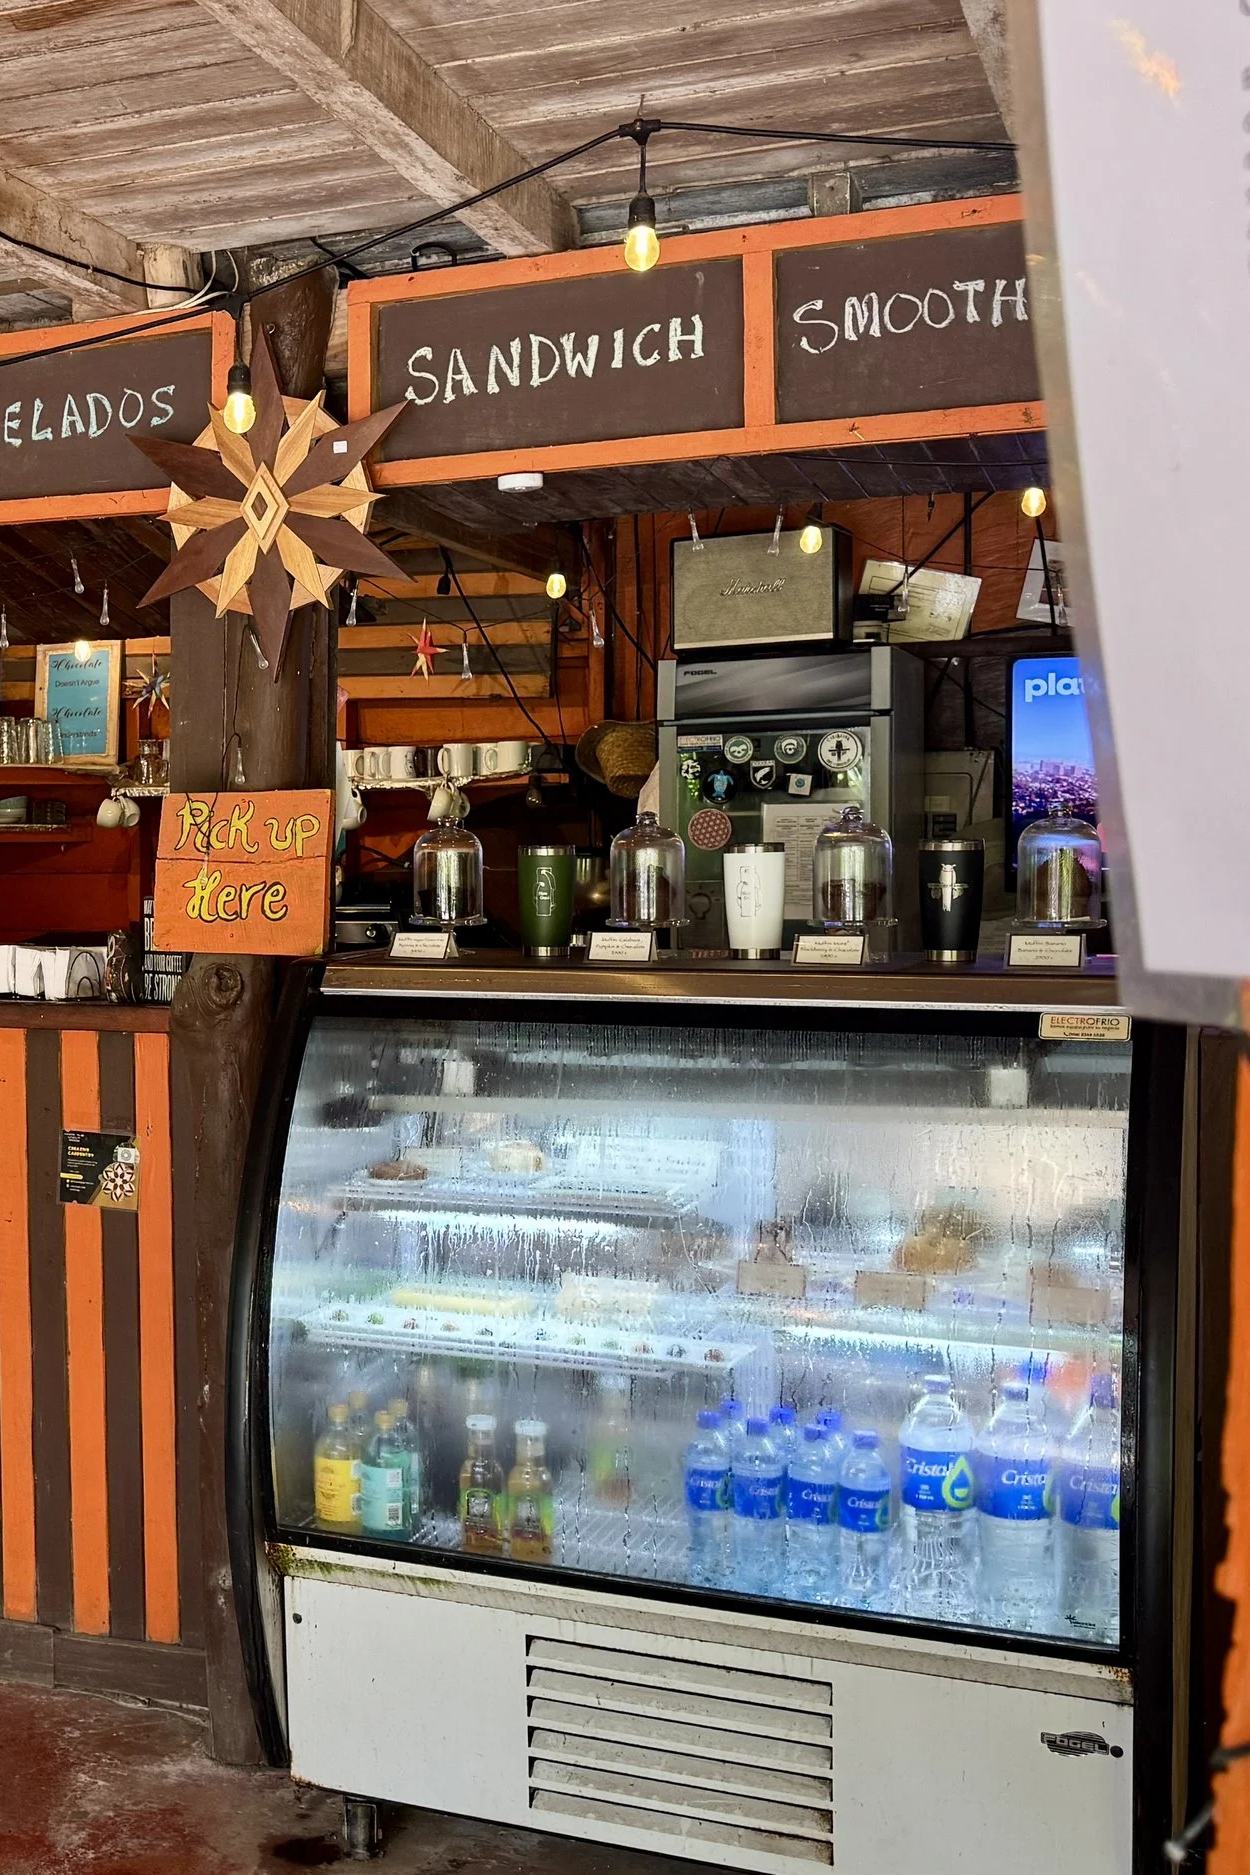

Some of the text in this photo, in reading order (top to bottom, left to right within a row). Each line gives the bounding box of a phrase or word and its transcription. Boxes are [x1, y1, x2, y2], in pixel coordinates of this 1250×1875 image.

[793, 278, 1028, 354] SMOOTH
[404, 313, 704, 404] SANDWICH
[81, 679, 100, 687] Argue
[683, 668, 717, 676] FOGEL
[182, 866, 288, 922] Here
[166, 955, 182, 972] COFFEE
[154, 974, 182, 1001] STRON
[1050, 1016, 1120, 1026] ELECTROFRIO
[1043, 1733, 1109, 1755] FOGEL
